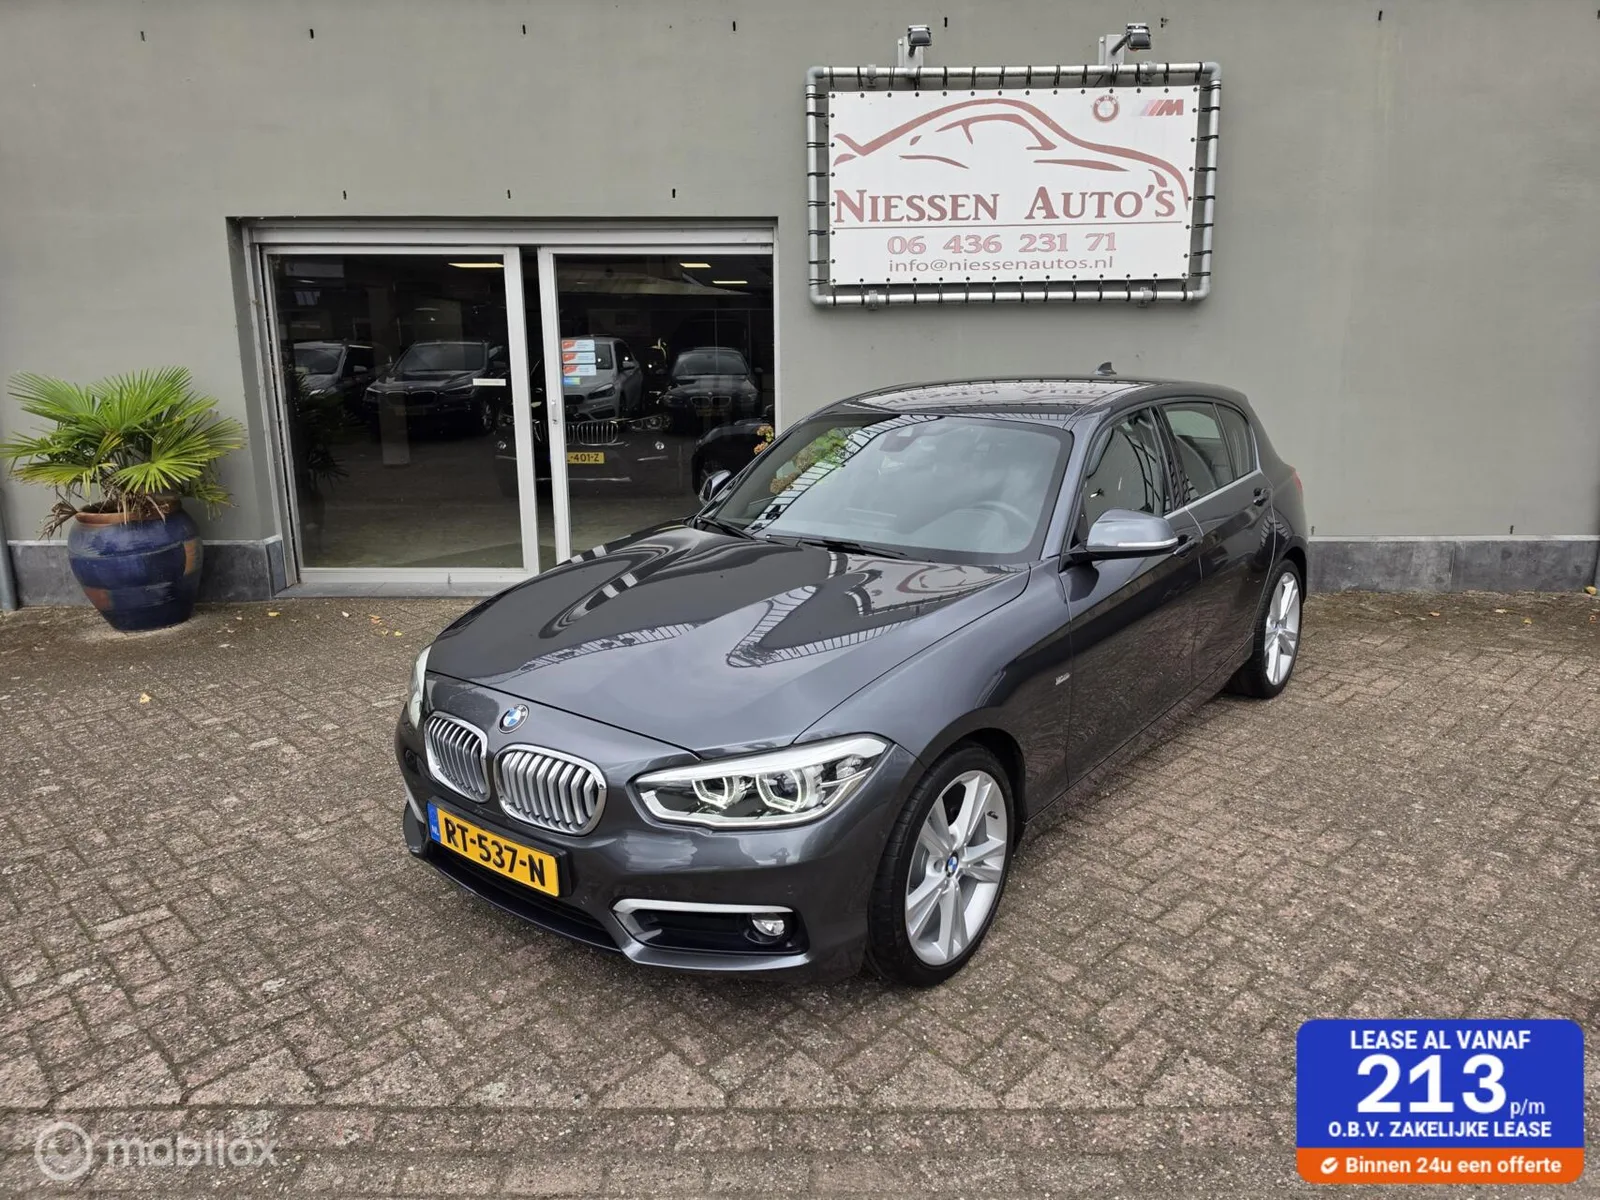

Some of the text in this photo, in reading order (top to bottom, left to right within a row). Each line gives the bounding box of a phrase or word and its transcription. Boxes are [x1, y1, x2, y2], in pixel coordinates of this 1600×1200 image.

[833, 183, 1177, 223] NIESSEN AUTO'S
[887, 231, 1117, 255] 06 436 231 71
[889, 256, 1113, 272] info@niessenautos.nl
[567, 453, 600, 462] -401-Z
[444, 817, 546, 887] RT-537-N
